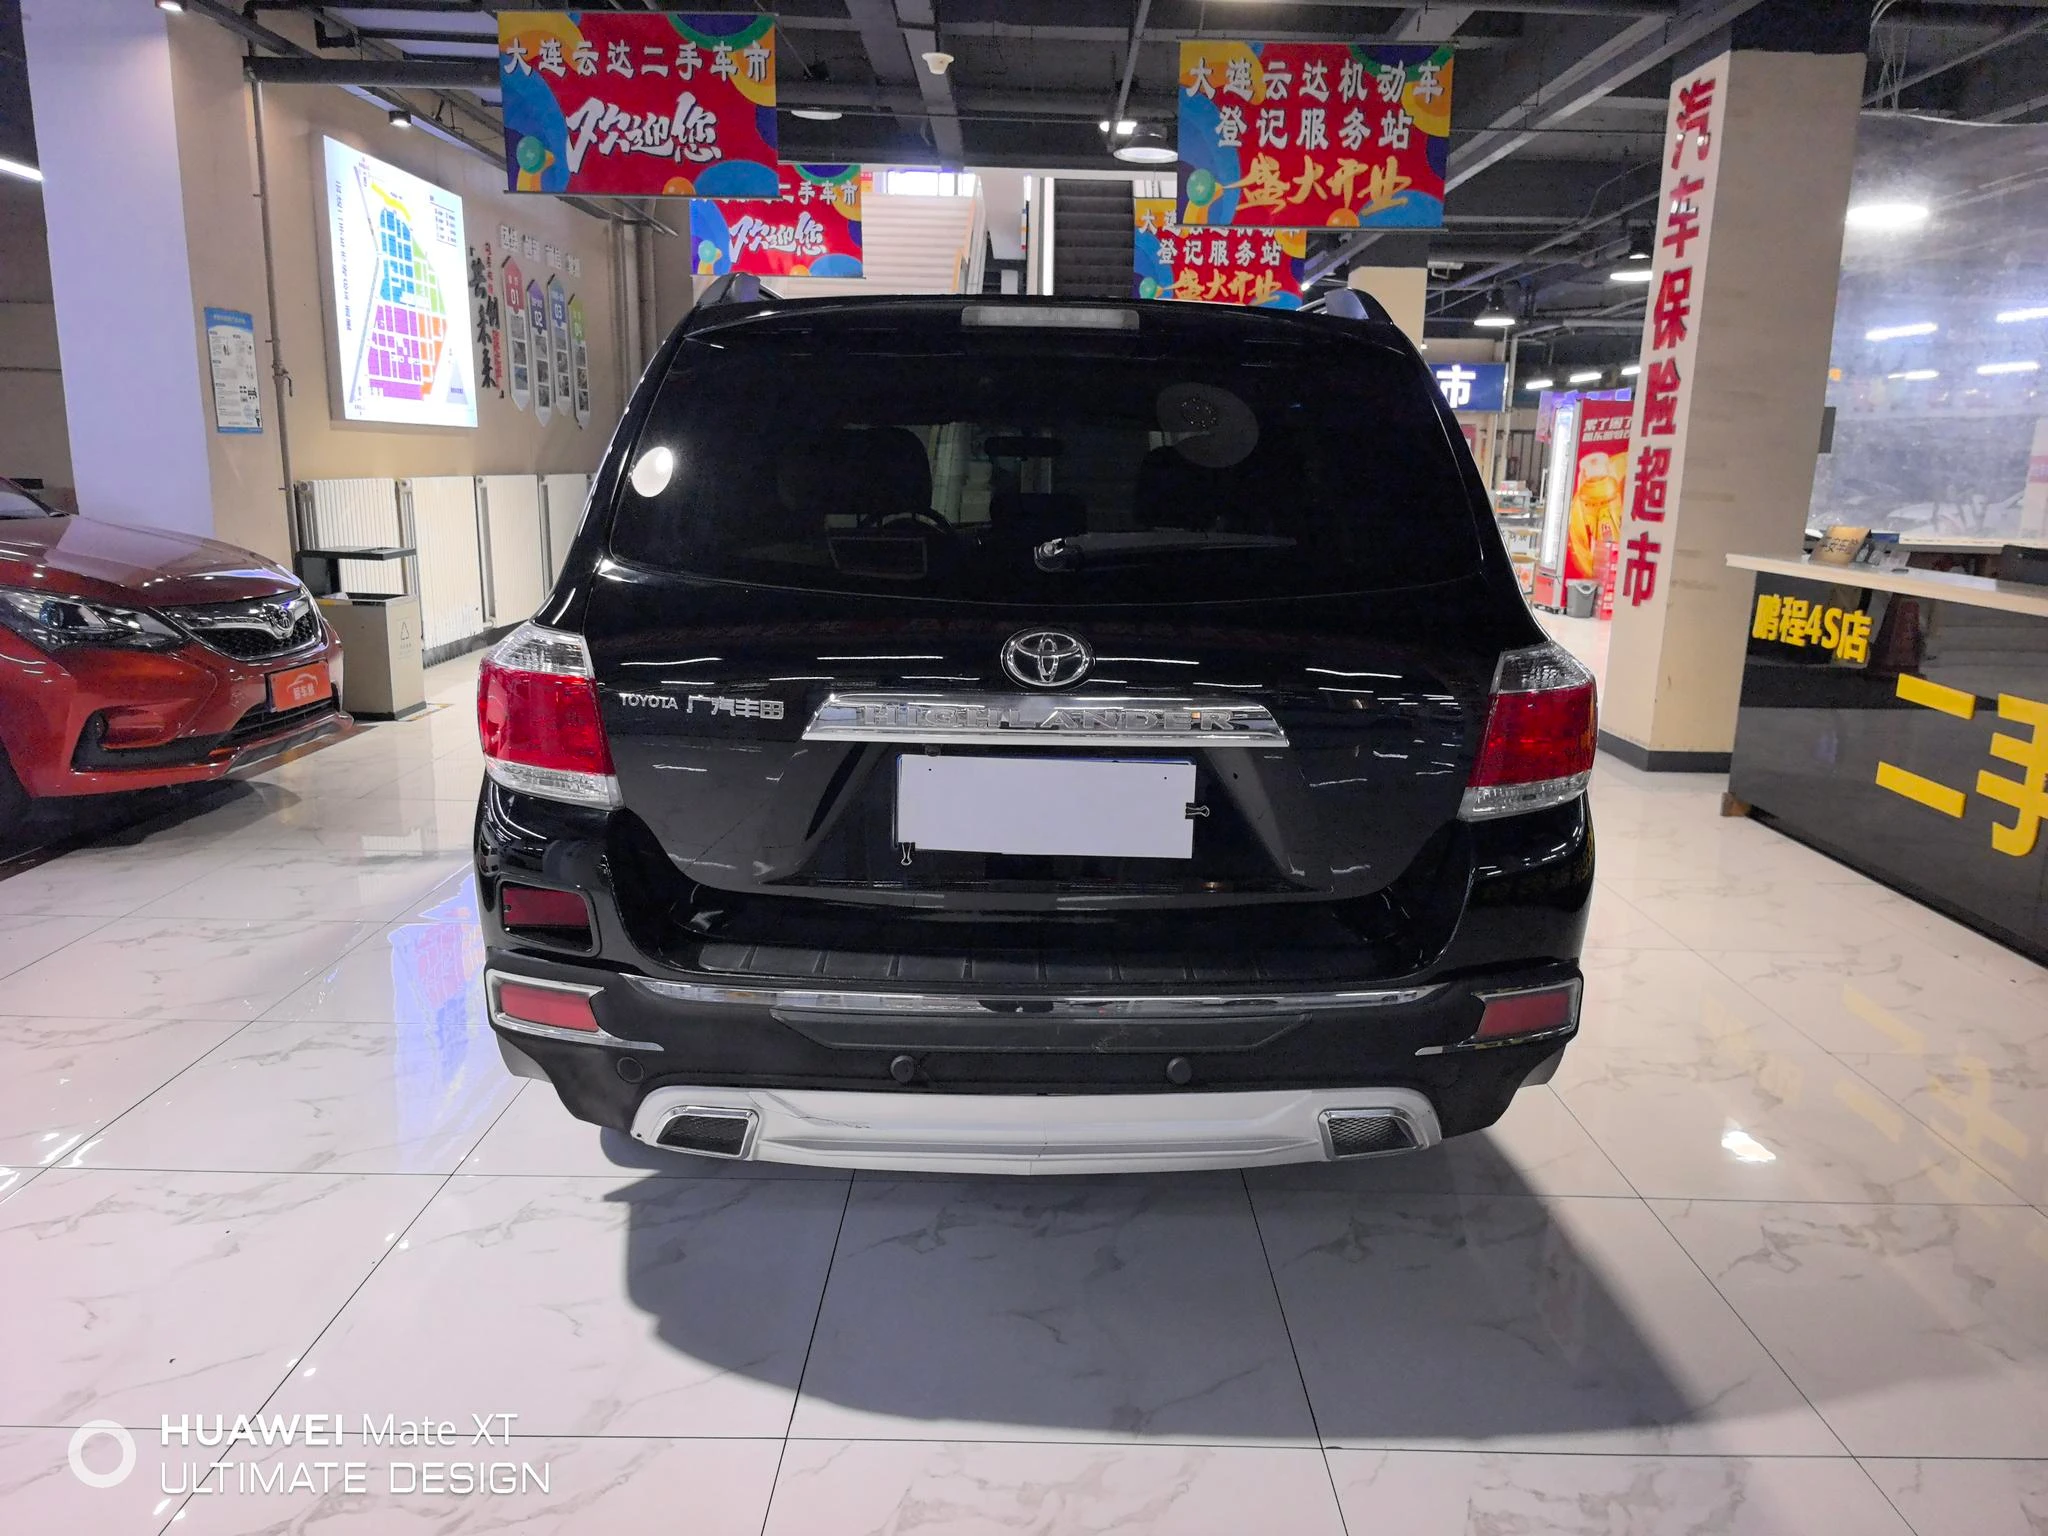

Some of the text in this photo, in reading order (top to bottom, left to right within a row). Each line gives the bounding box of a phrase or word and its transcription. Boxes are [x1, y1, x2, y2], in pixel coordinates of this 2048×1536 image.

[503, 38, 771, 82] 大连云达二手车市
[1186, 57, 1444, 104] 大连云达机动车
[565, 91, 723, 174] 欢迎您
[1214, 105, 1414, 151] 登记服务站
[1224, 151, 1413, 217] 盛大开业
[728, 210, 828, 264] 欢迎您
[1157, 238, 1283, 267] 登记服务站
[1163, 266, 1283, 305] 盛大开业
[1623, 78, 1717, 608] 汽车保险超市
[1752, 593, 1873, 664] 鹏程4S店
[619, 692, 679, 711] TOYOTA
[686, 694, 784, 720] 广汽丰田
[863, 704, 1235, 731] HIGHLANDER
